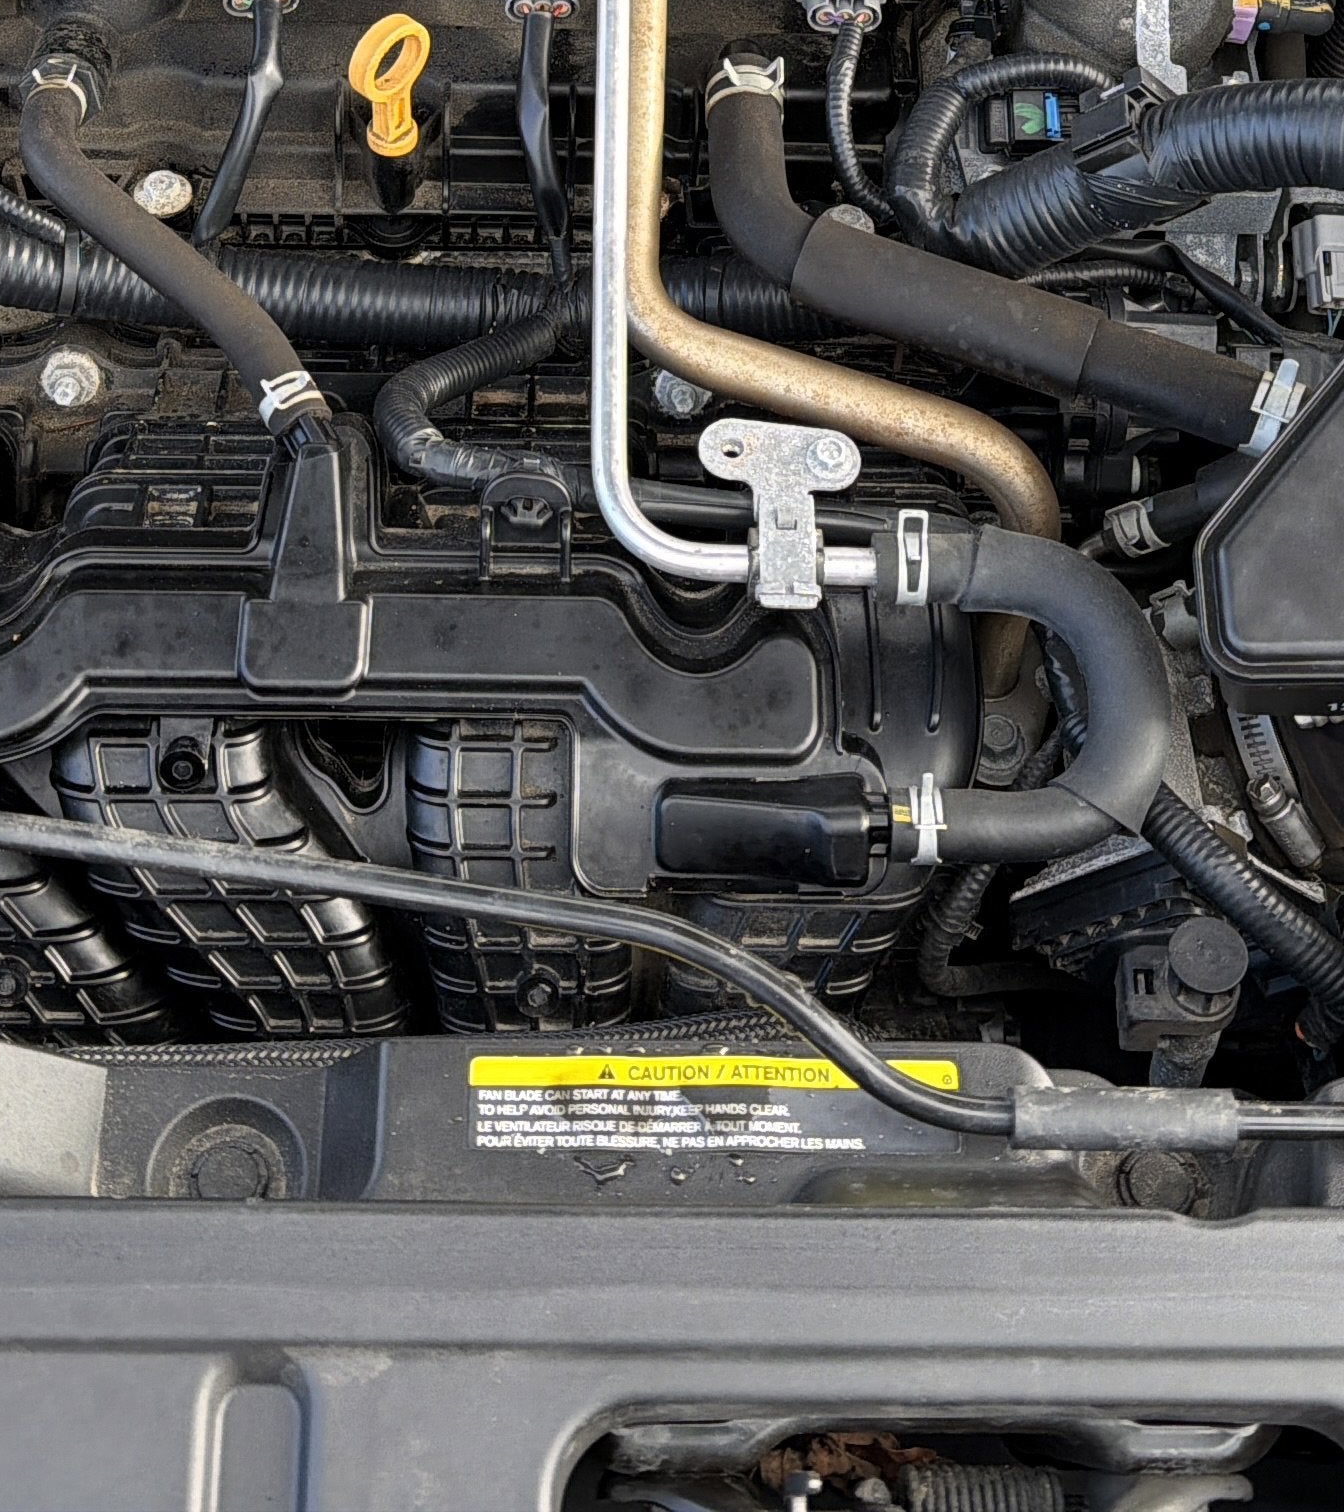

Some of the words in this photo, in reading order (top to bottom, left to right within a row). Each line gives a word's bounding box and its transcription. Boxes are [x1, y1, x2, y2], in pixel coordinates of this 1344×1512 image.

[628, 1065, 709, 1080] CAUTION
[731, 1064, 829, 1082] ATTENTION
[478, 1090, 503, 1101] FAN
[505, 1090, 543, 1101] BLADE
[545, 1090, 571, 1101] CAN
[573, 1089, 609, 1101] START
[610, 1090, 625, 1101] AT
[627, 1090, 651, 1101] ANY
[477, 1104, 494, 1116] TO
[496, 1104, 528, 1116] HELP
[529, 1104, 566, 1116] AVOID
[568, 1104, 630, 1116] PERSONAL
[706, 1103, 747, 1115] HANDS
[477, 1121, 492, 1132] LE
[494, 1121, 571, 1132] VENTILATEUR
[573, 1120, 616, 1132] RISQUE
[619, 1121, 635, 1132] DE
[716, 1121, 747, 1132] TOUT
[476, 1136, 511, 1147] POUR
[514, 1133, 554, 1147] ÉVITER
[555, 1136, 594, 1147] TOUTE
[663, 1137, 680, 1148] NE
[682, 1137, 705, 1148] PAS
[707, 1136, 725, 1148] EN
[726, 1136, 800, 1148] APPROCHER
[801, 1138, 824, 1149] LES
